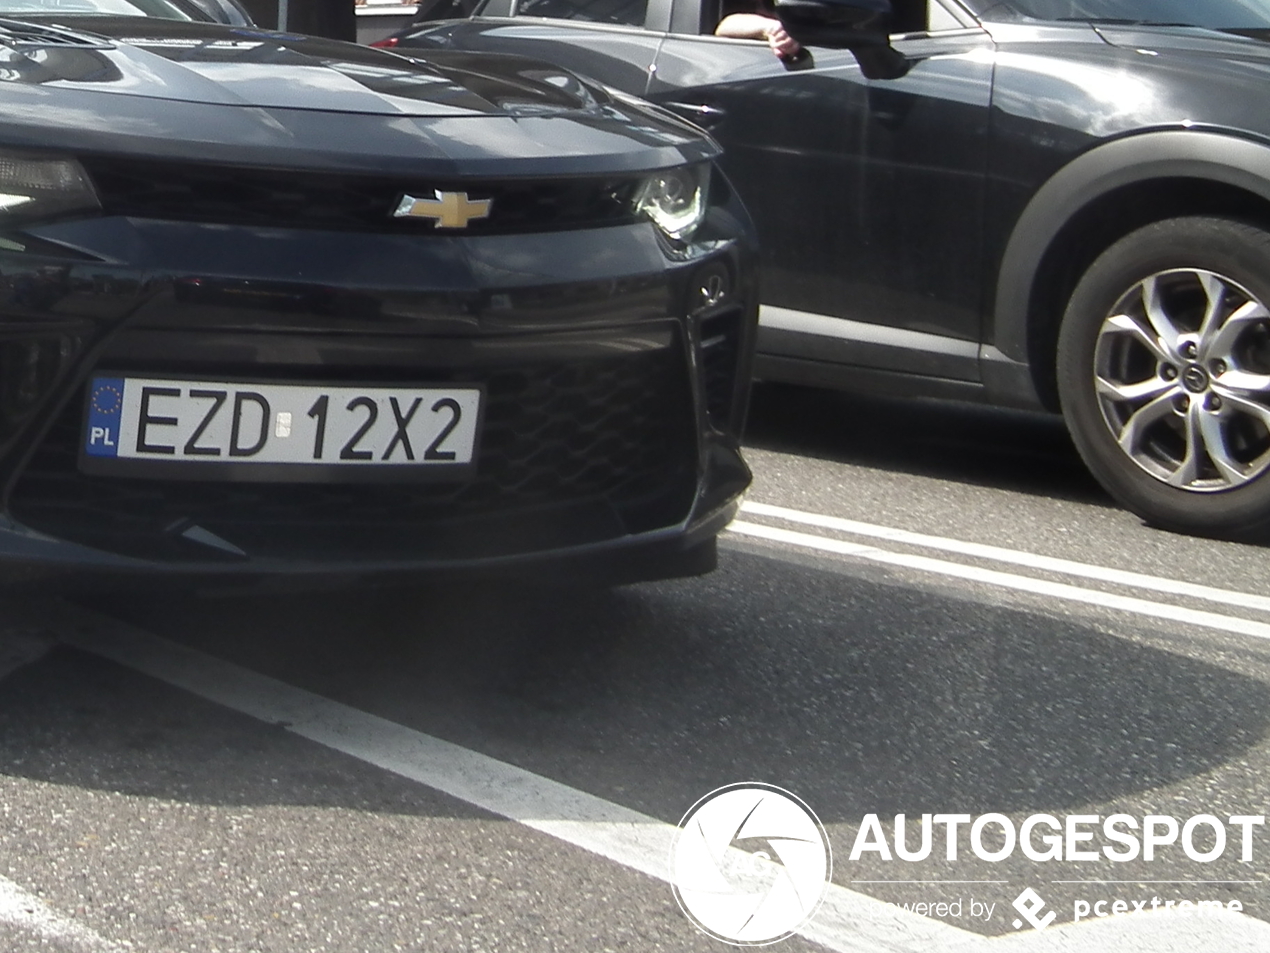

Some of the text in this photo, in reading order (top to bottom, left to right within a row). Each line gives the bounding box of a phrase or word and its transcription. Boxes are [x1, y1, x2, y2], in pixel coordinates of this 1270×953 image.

[90, 427, 114, 446] PL
[136, 386, 462, 461] EZD 12X2
